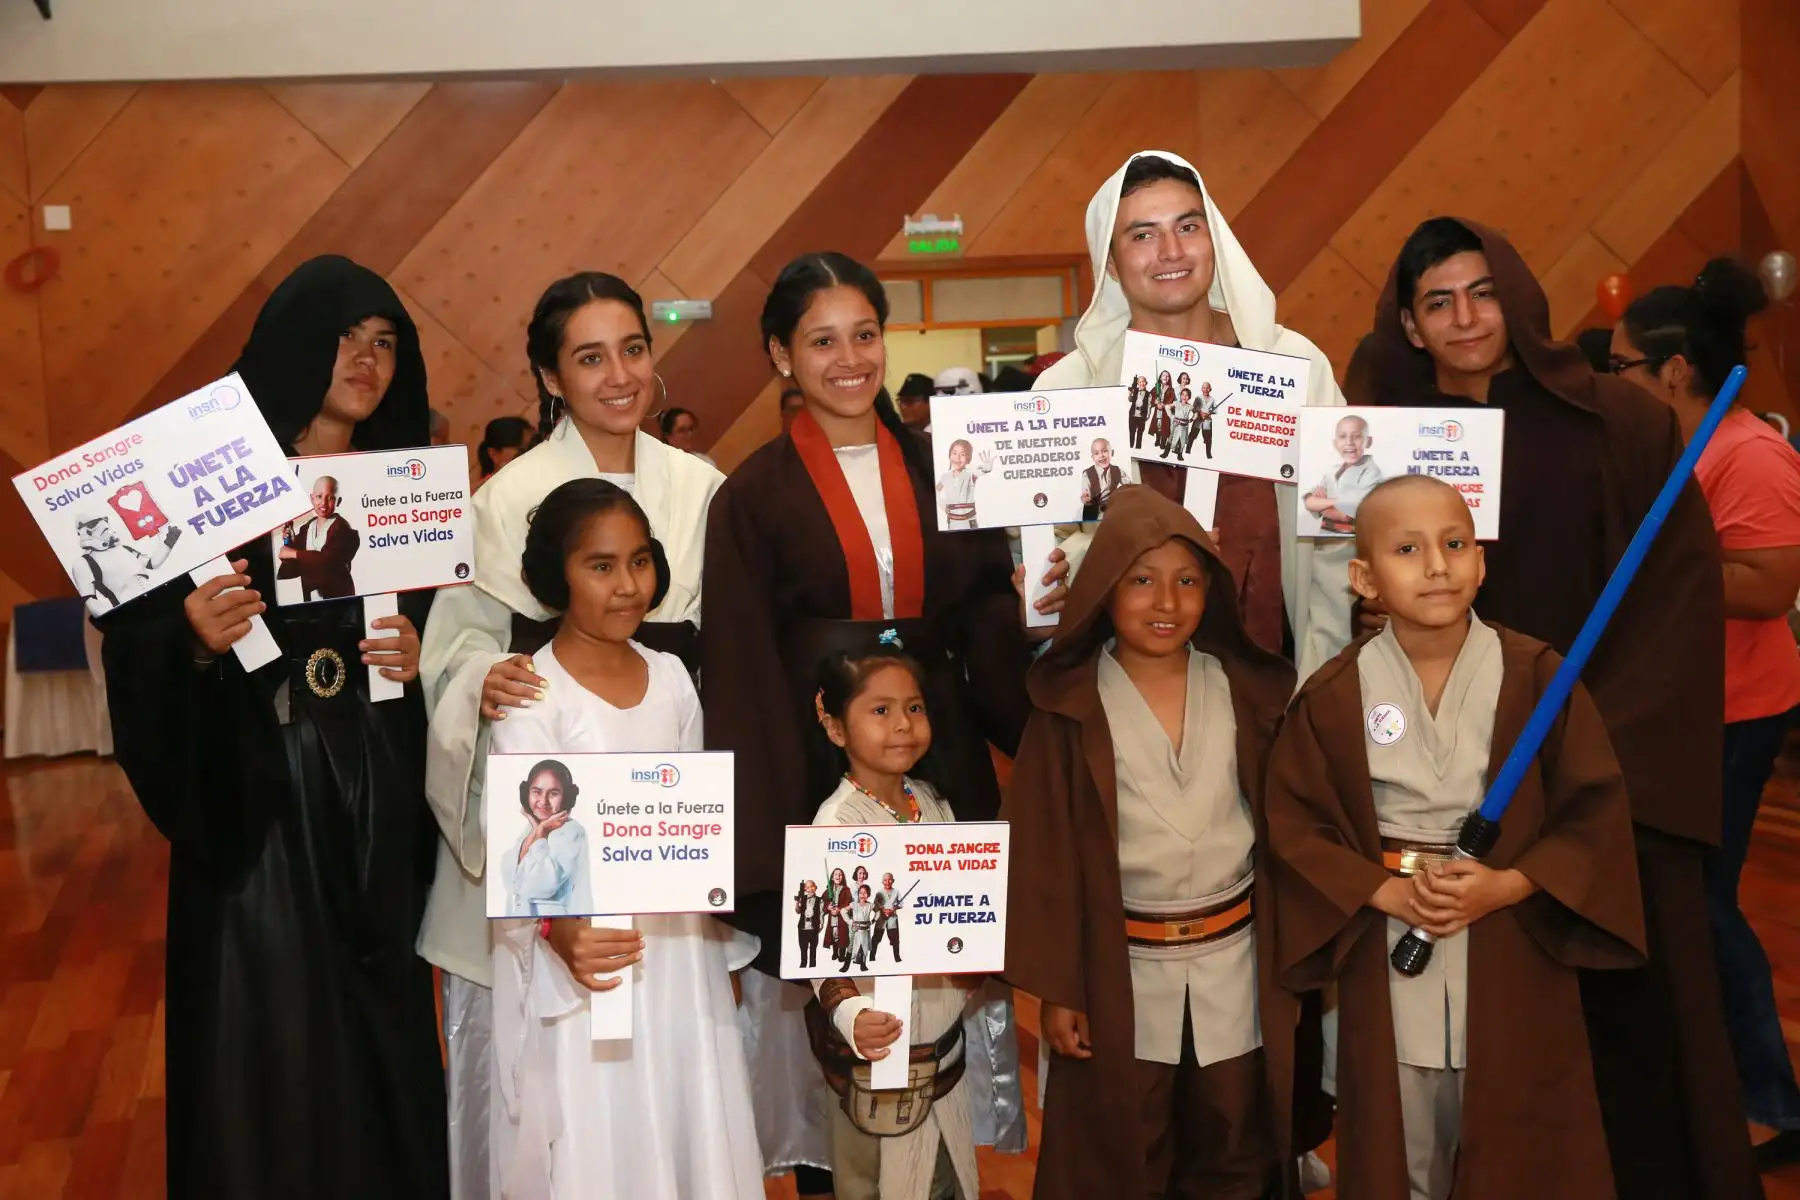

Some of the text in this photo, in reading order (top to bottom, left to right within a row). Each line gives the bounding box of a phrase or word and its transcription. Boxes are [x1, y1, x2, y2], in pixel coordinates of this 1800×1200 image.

[1227, 367, 1295, 388] ÚNETE A LA
[1239, 383, 1285, 400] FUERZA
[966, 415, 1107, 434] ÚNETE A LA FUERZA
[1227, 406, 1297, 425] DE NUESTROS
[1226, 418, 1296, 436] VERDADEROS
[995, 436, 1078, 451] DE NUESTROS
[1229, 431, 1290, 448] GUERREROS
[33, 432, 145, 492] Dona Sangre
[167, 437, 254, 489] ÚNETE
[999, 451, 1081, 466] VERDADEROS
[1412, 447, 1470, 462] ÚNETE A
[1003, 466, 1074, 480] GUERREROS
[1427, 465, 1480, 477] FUERZA
[45, 457, 145, 512] Salva Vidas
[193, 464, 258, 508] A LA
[187, 475, 293, 536] FUERZA
[361, 489, 463, 509] Únete a la Fuerza
[367, 507, 463, 528] Dona Sangre
[368, 527, 454, 549] Salva Vidas
[597, 799, 725, 815] Únete a la Fuerza
[602, 820, 722, 840] Dona Sangre
[602, 844, 709, 863] Salva Vidas
[904, 842, 1001, 855] DONA SANGRE
[908, 859, 997, 872] SALVA VIDAS
[913, 893, 991, 908] SÚMATE A
[914, 911, 997, 925] SU FUERZA
